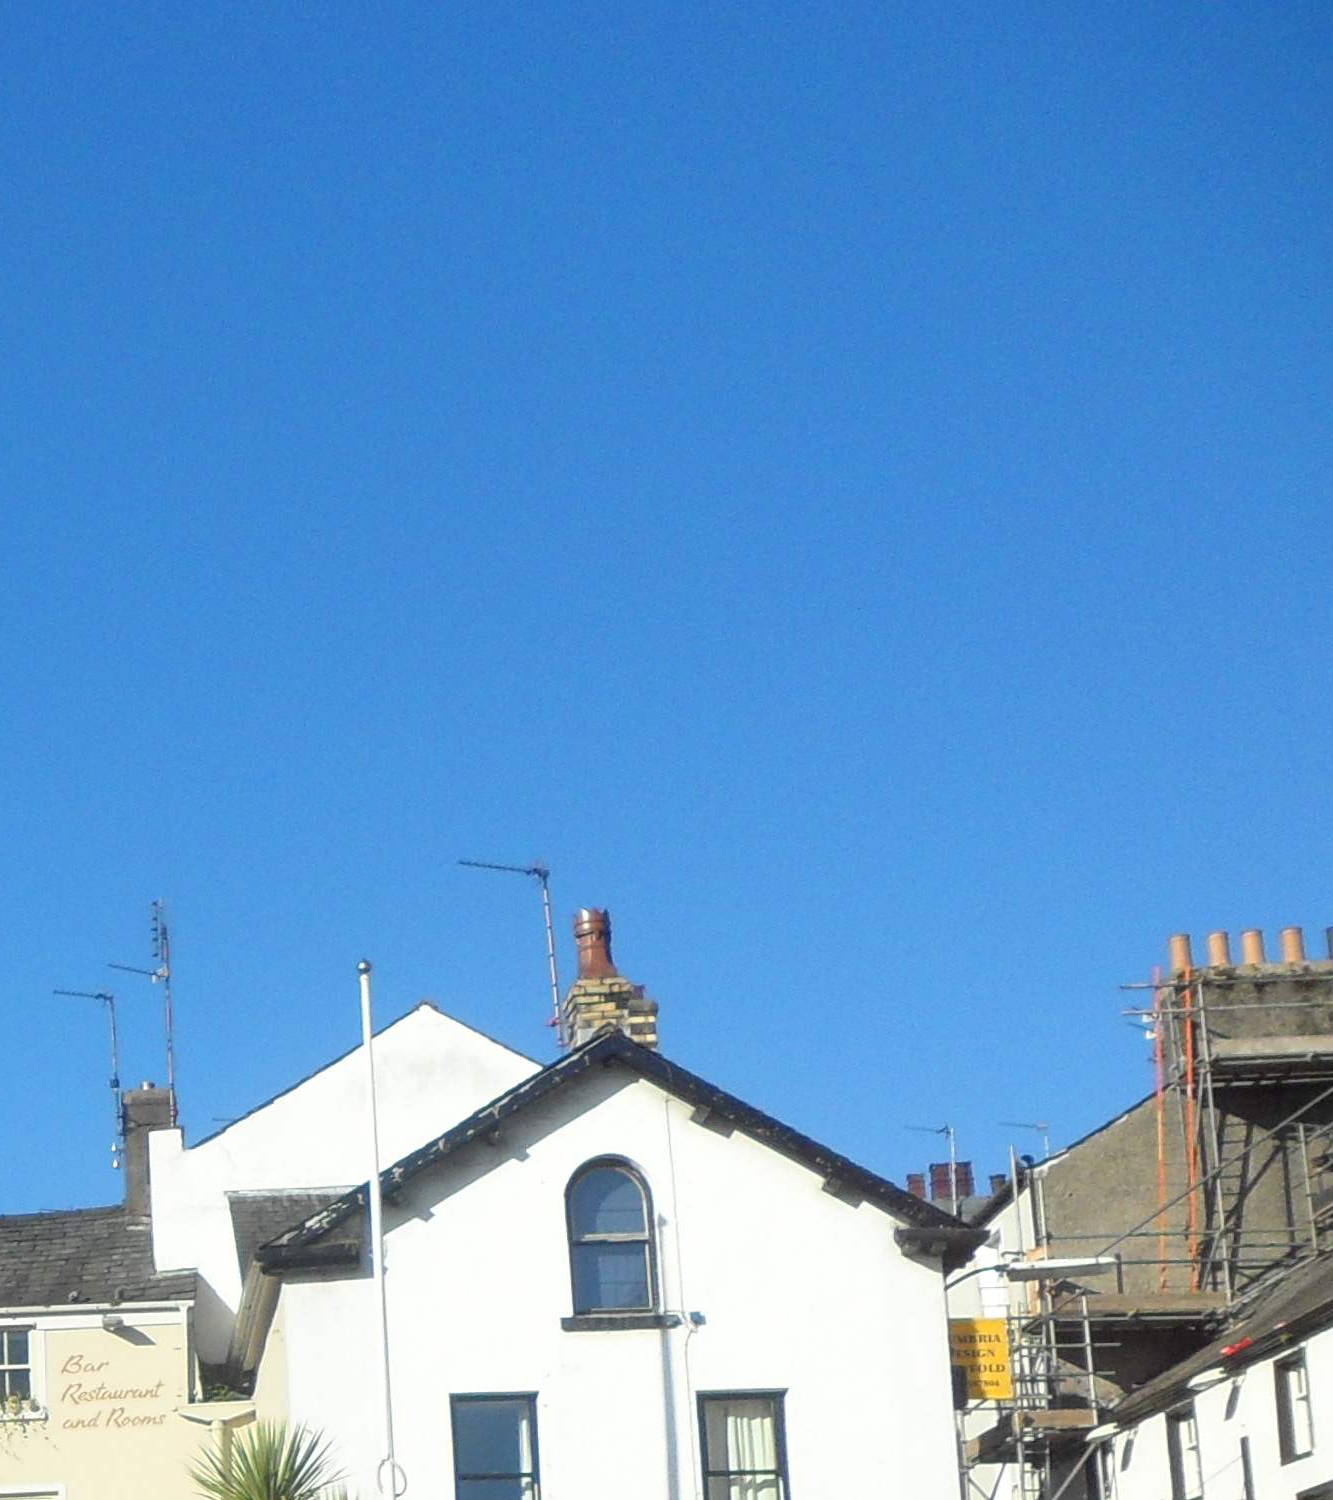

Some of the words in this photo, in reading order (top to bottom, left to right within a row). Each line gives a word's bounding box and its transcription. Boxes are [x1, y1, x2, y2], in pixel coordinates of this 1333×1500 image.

[61, 1354, 110, 1375] Bar
[61, 1379, 165, 1405] Restaurant
[61, 1411, 101, 1429] and
[105, 1406, 167, 1429] Rooms
